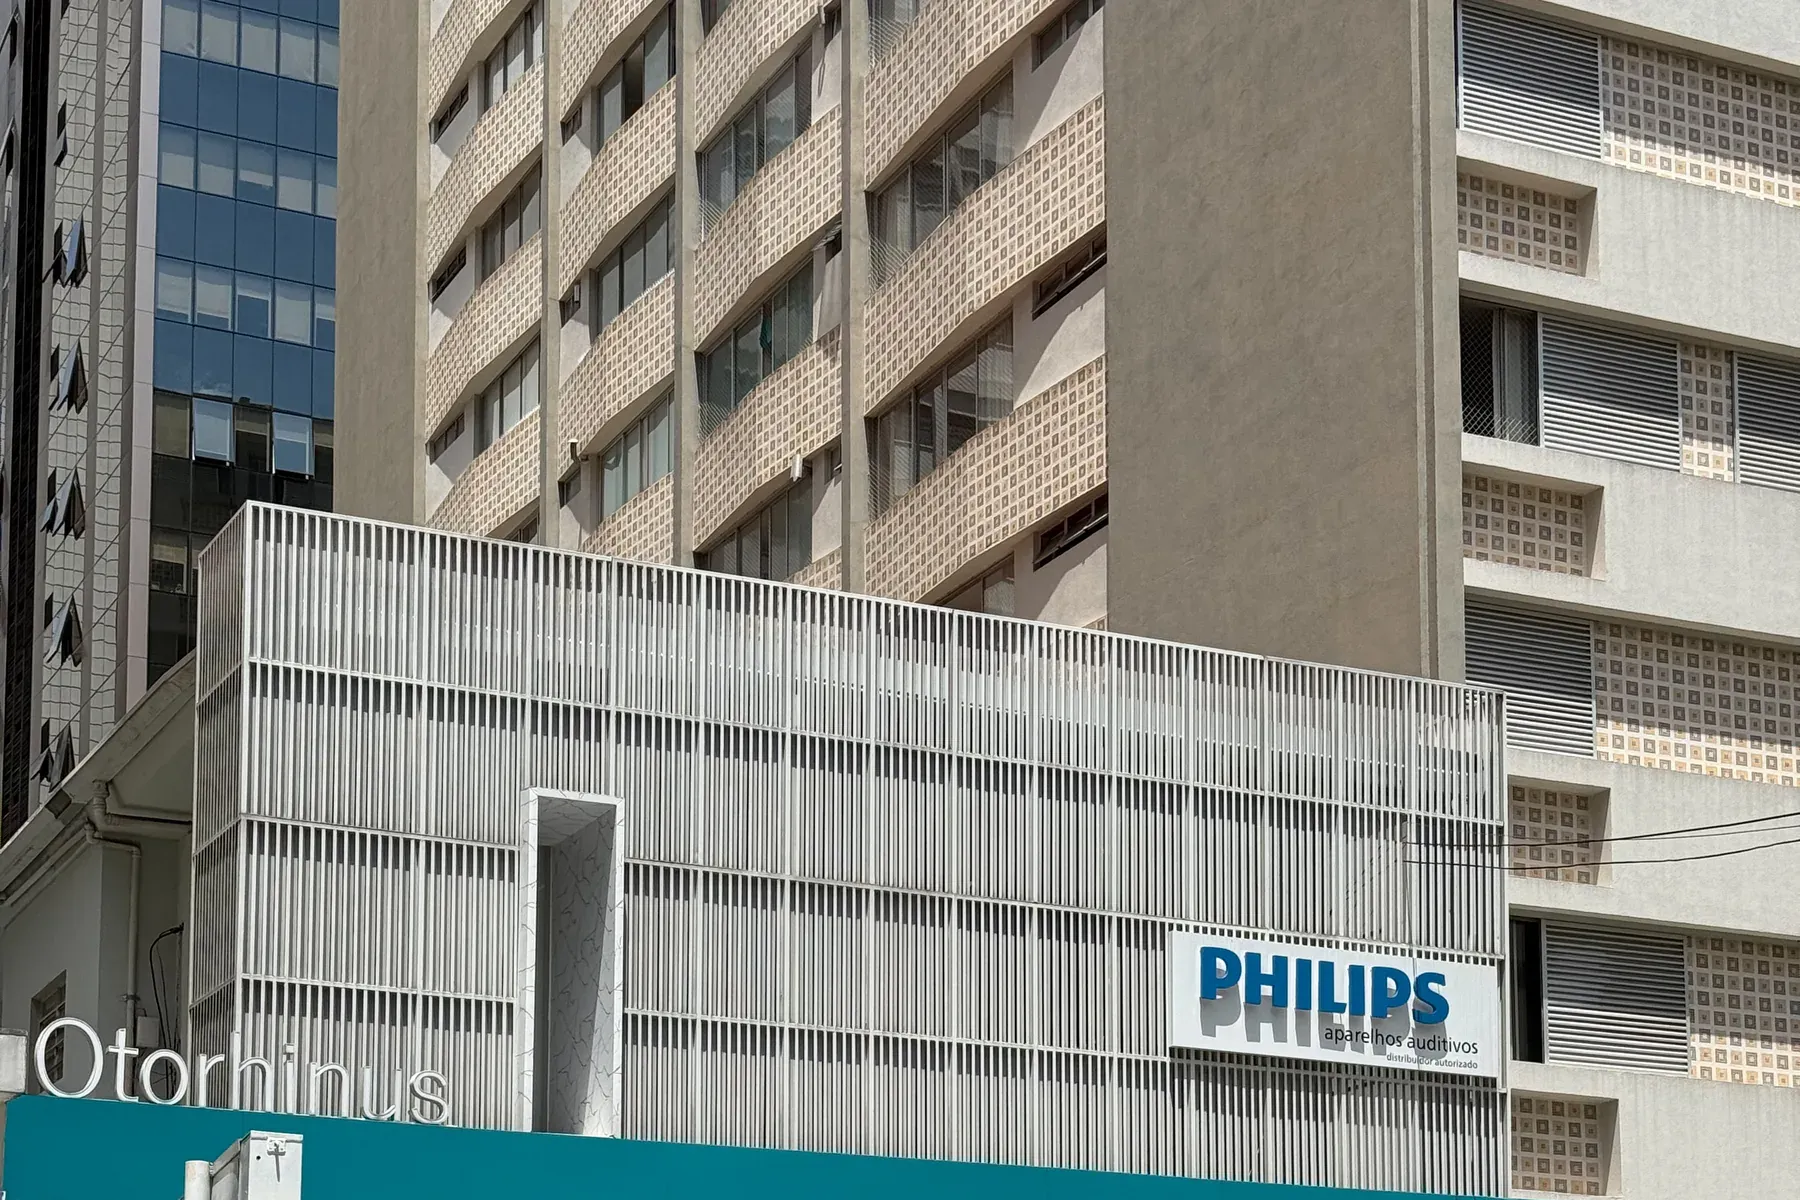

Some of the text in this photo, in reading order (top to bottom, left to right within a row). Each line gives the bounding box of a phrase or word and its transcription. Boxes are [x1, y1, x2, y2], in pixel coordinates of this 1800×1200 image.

[1199, 945, 1450, 1025] PHILIPS
[1324, 1027, 1479, 1054] aparelhos auditivos
[1386, 1053, 1478, 1069] distribuidor autorizado
[33, 1016, 450, 1126] Otorhinus
